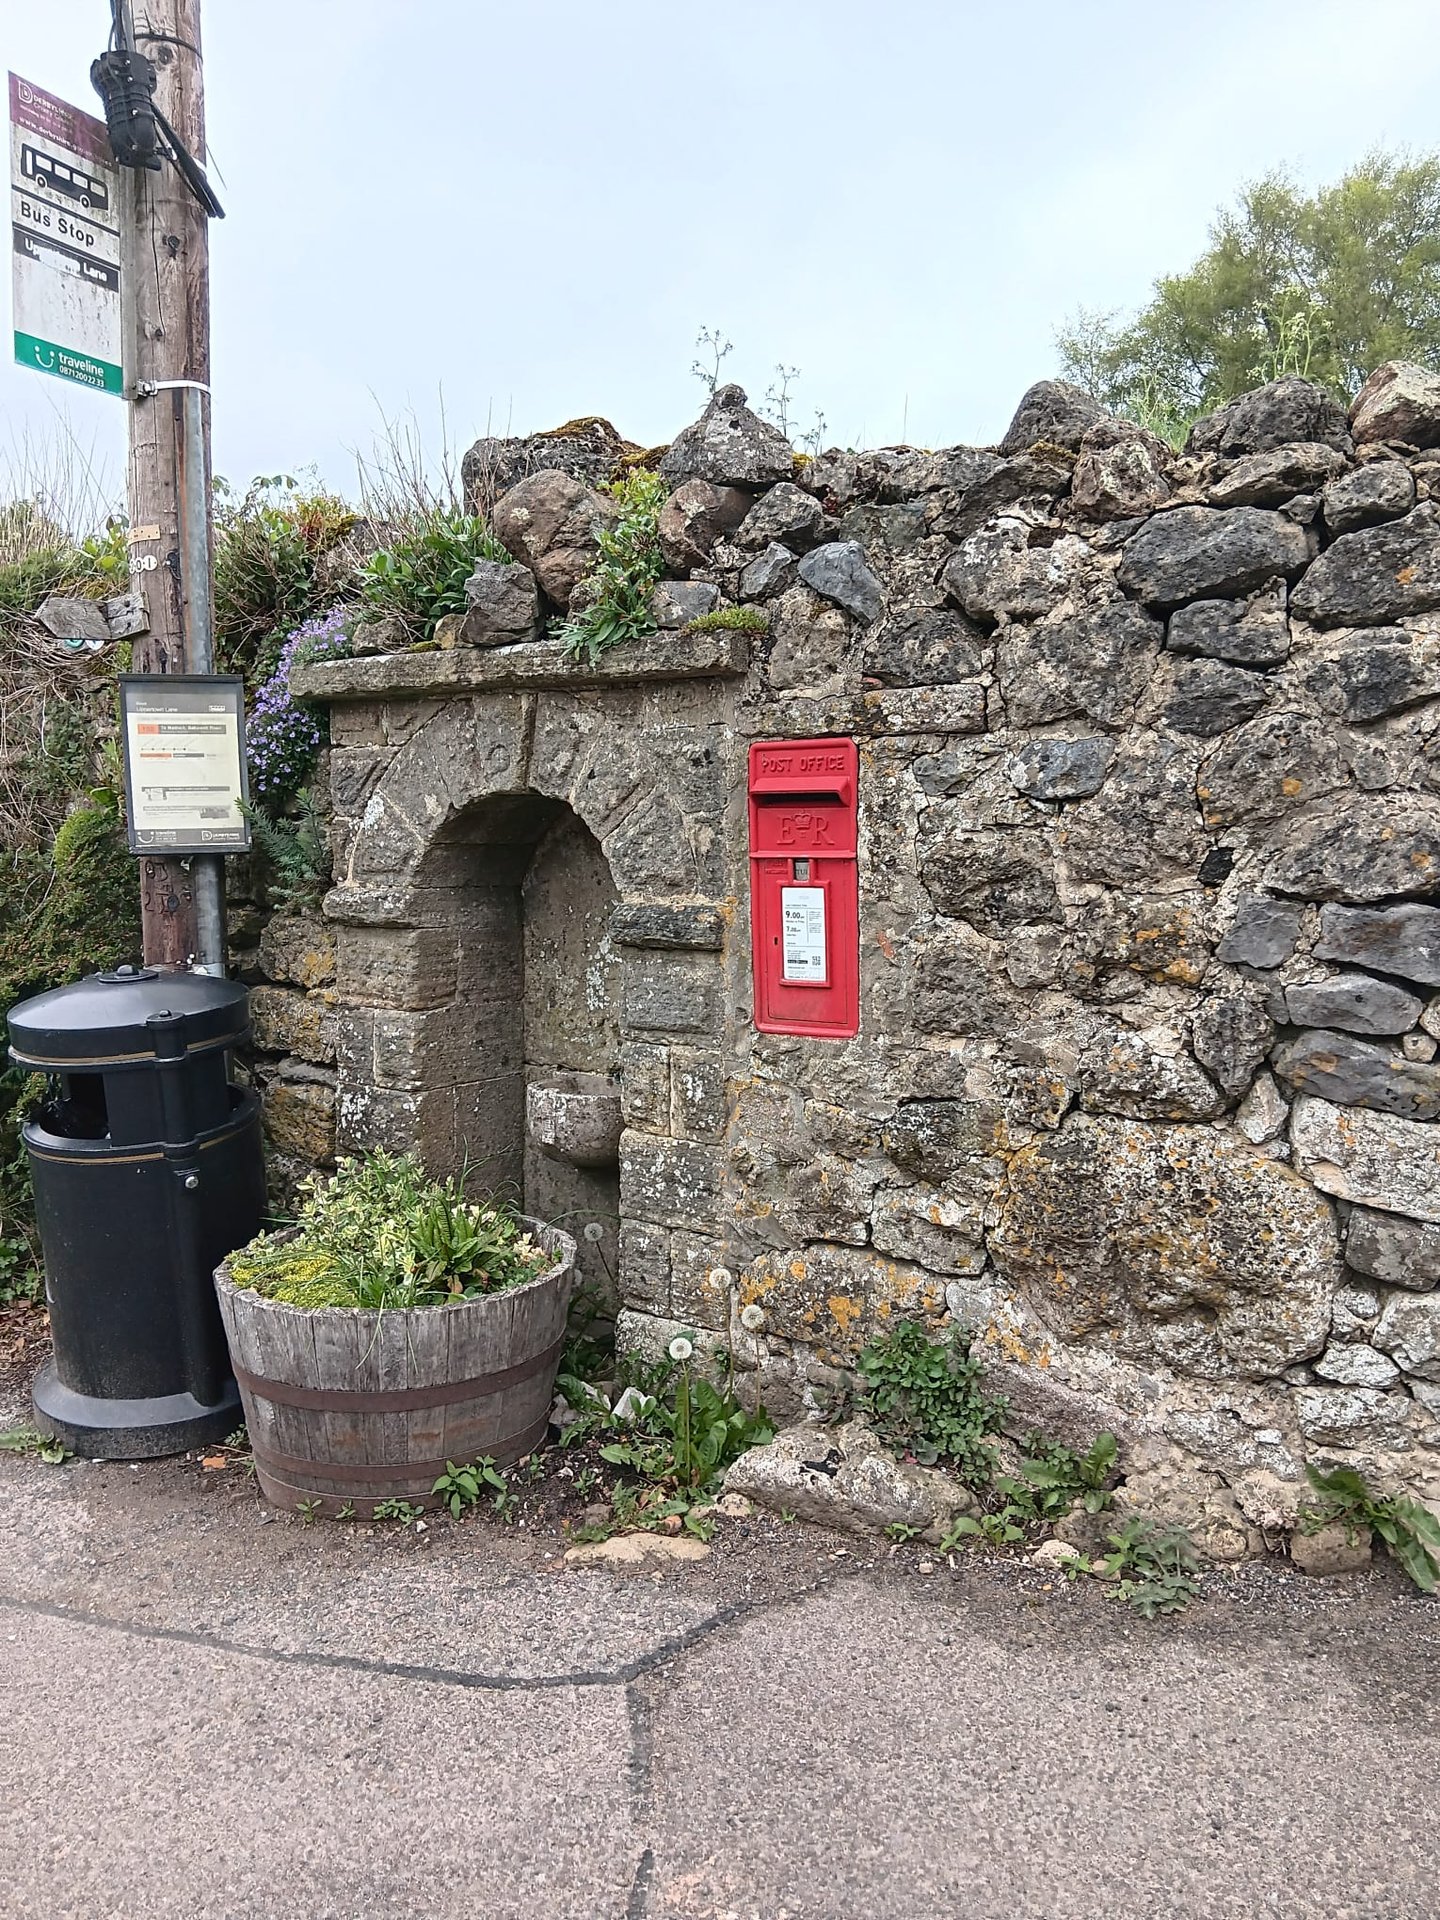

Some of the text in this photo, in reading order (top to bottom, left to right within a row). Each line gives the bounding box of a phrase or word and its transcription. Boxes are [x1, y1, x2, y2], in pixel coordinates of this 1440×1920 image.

[21, 200, 94, 247] Bus Stop
[83, 262, 107, 282] Lane
[58, 351, 104, 377] traveline
[762, 755, 845, 773] POST OFFICE
